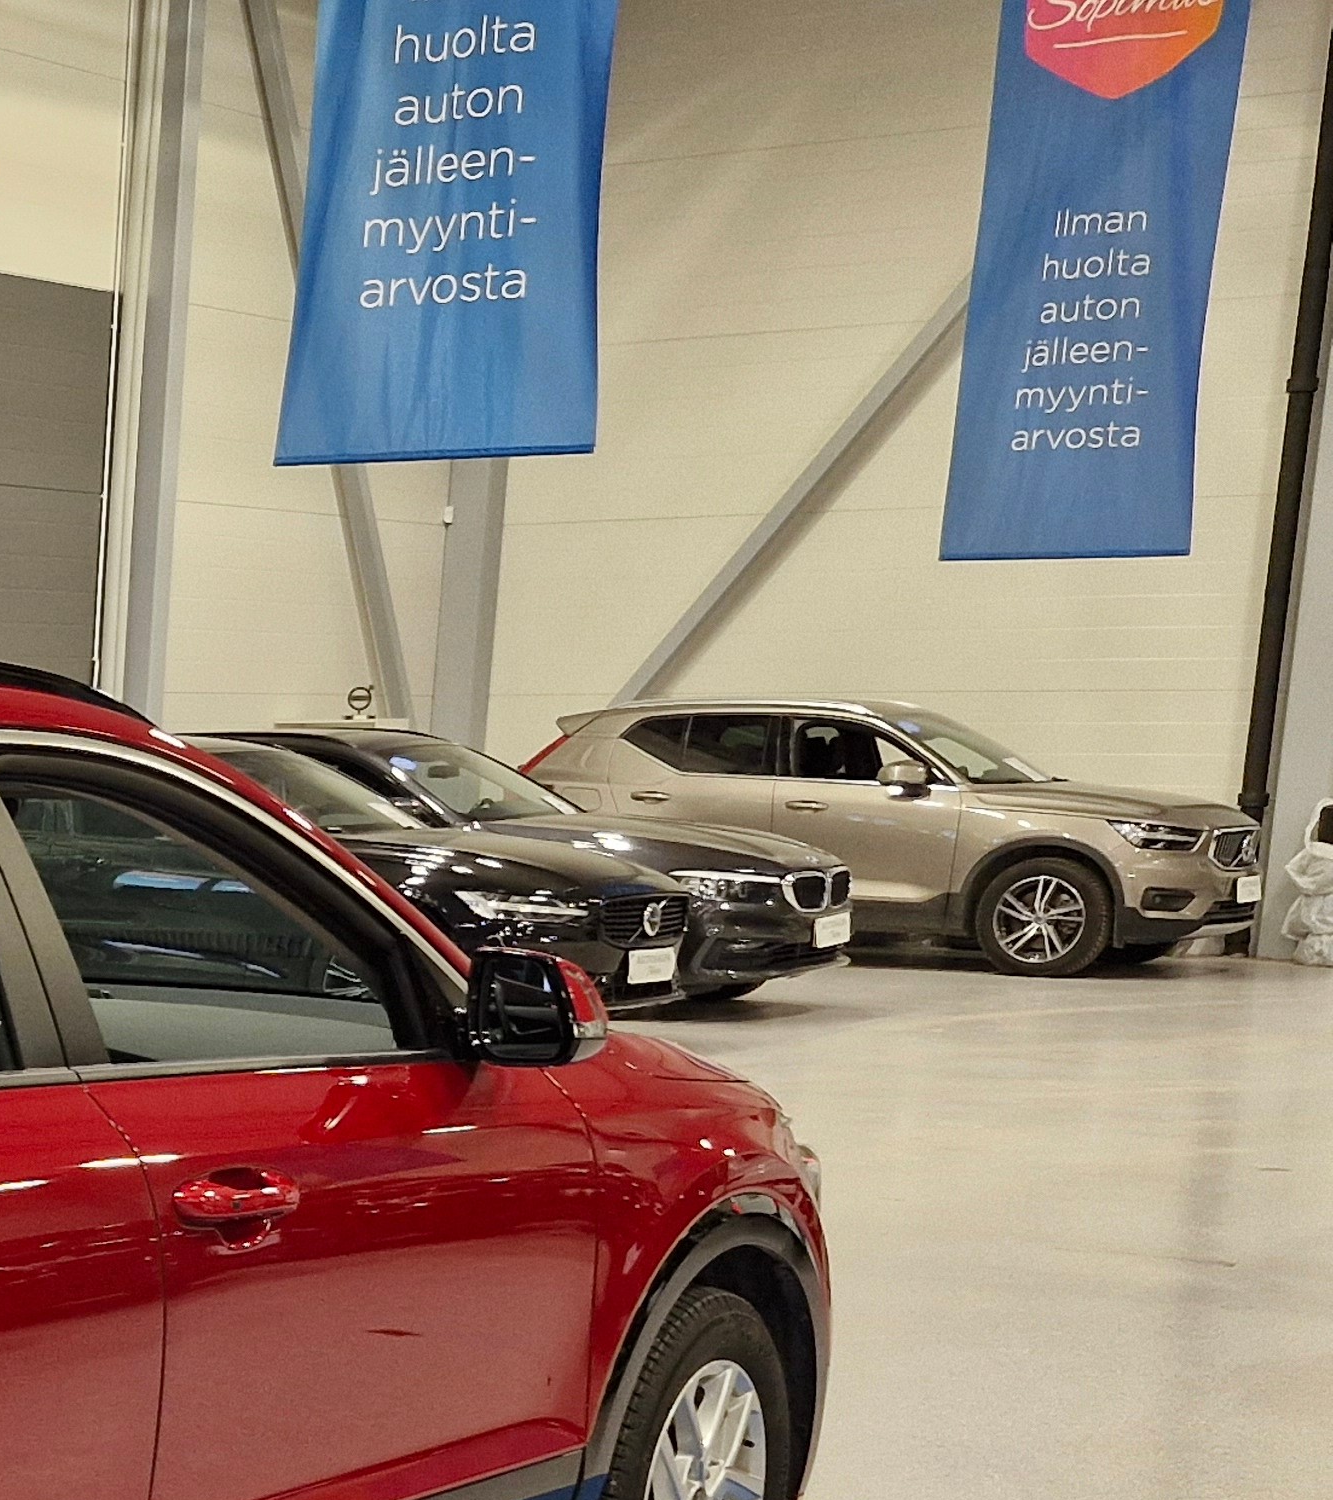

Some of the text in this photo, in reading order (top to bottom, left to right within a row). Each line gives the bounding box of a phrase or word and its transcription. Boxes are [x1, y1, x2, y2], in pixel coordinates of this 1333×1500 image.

[394, 14, 536, 64] huolta
[394, 82, 525, 126] auton
[369, 143, 536, 196] jälleen-
[362, 197, 538, 254] myynti-
[1053, 208, 1148, 238] Ilman
[1041, 246, 1151, 282] huolta
[359, 262, 528, 309] arvosta
[1039, 293, 1141, 324] auton
[1020, 335, 1150, 374] jälleen-
[1014, 375, 1150, 414] myynti-
[1010, 420, 1142, 452] arvosta
